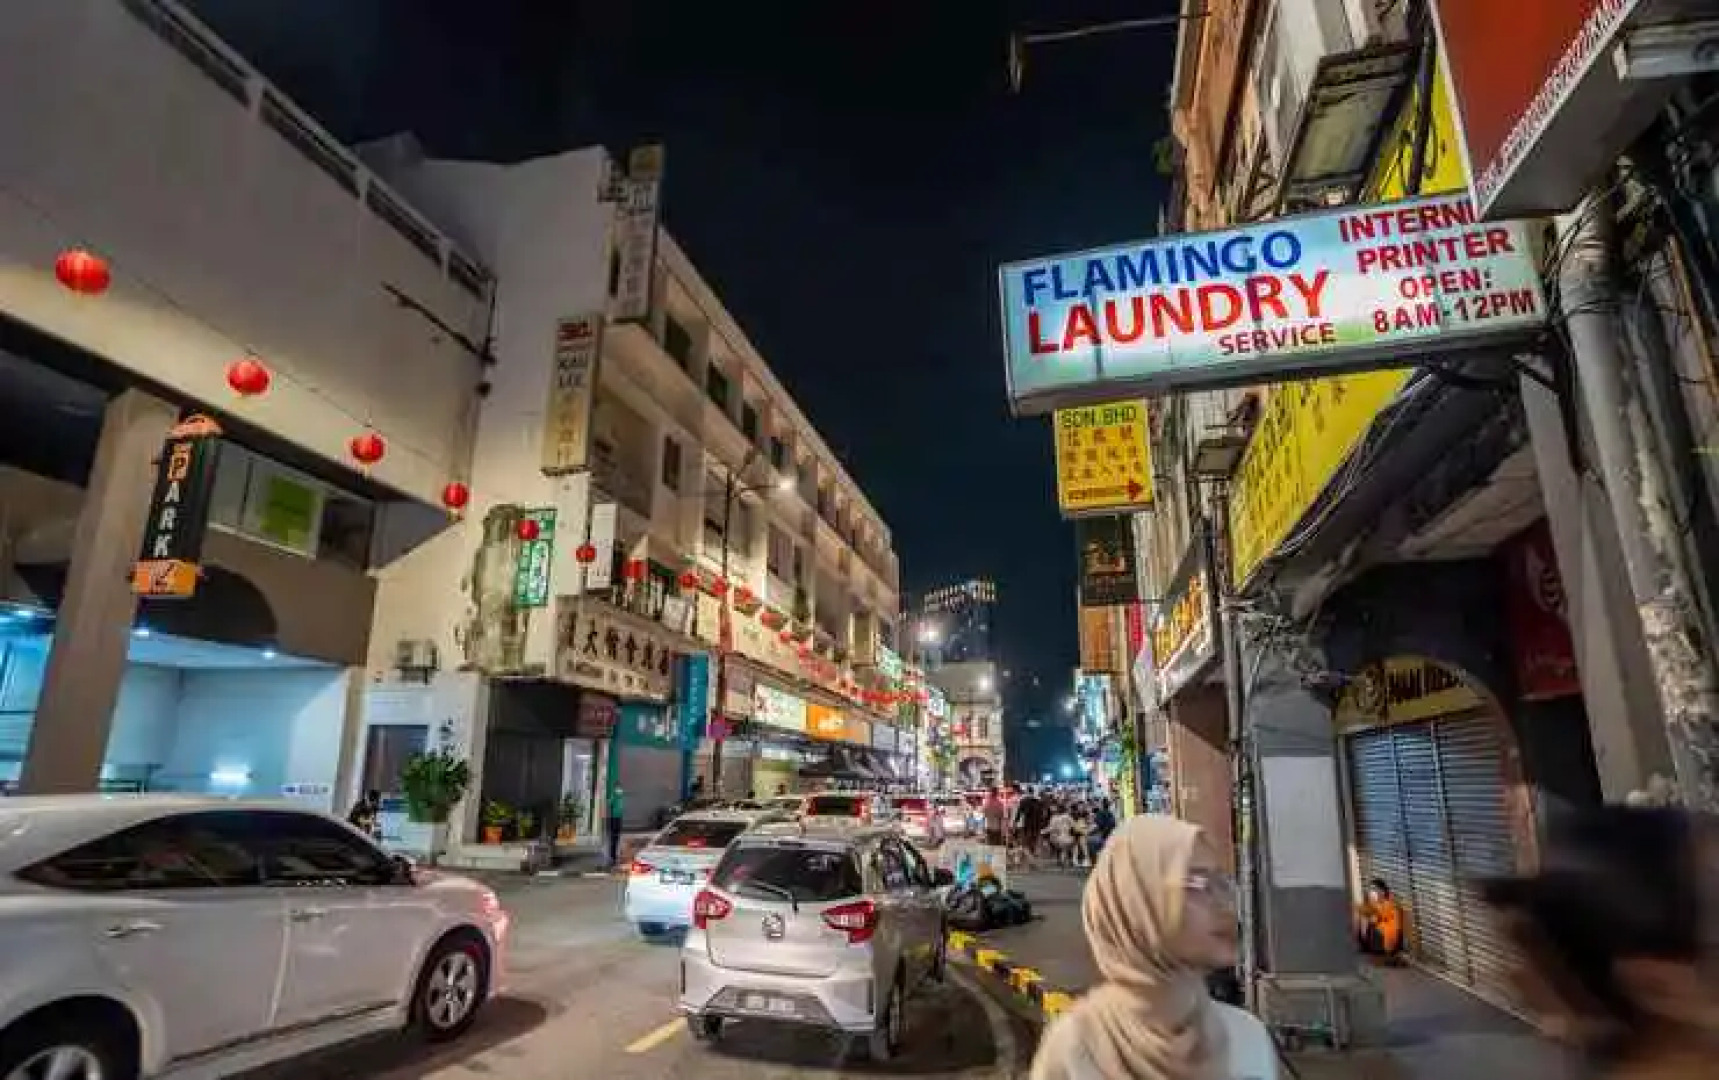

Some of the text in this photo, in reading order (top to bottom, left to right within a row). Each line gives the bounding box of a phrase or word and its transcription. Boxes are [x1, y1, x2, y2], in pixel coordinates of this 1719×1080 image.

[1023, 231, 1302, 306] FLAMINGO
[1357, 229, 1514, 274] PRINTER
[1400, 268, 1492, 299] OPEN:
[1028, 271, 1330, 354] LAUNDRY
[1373, 289, 1535, 335] 8AM-12PM
[1218, 322, 1336, 356] SERVICE
[153, 443, 194, 557] PARK
